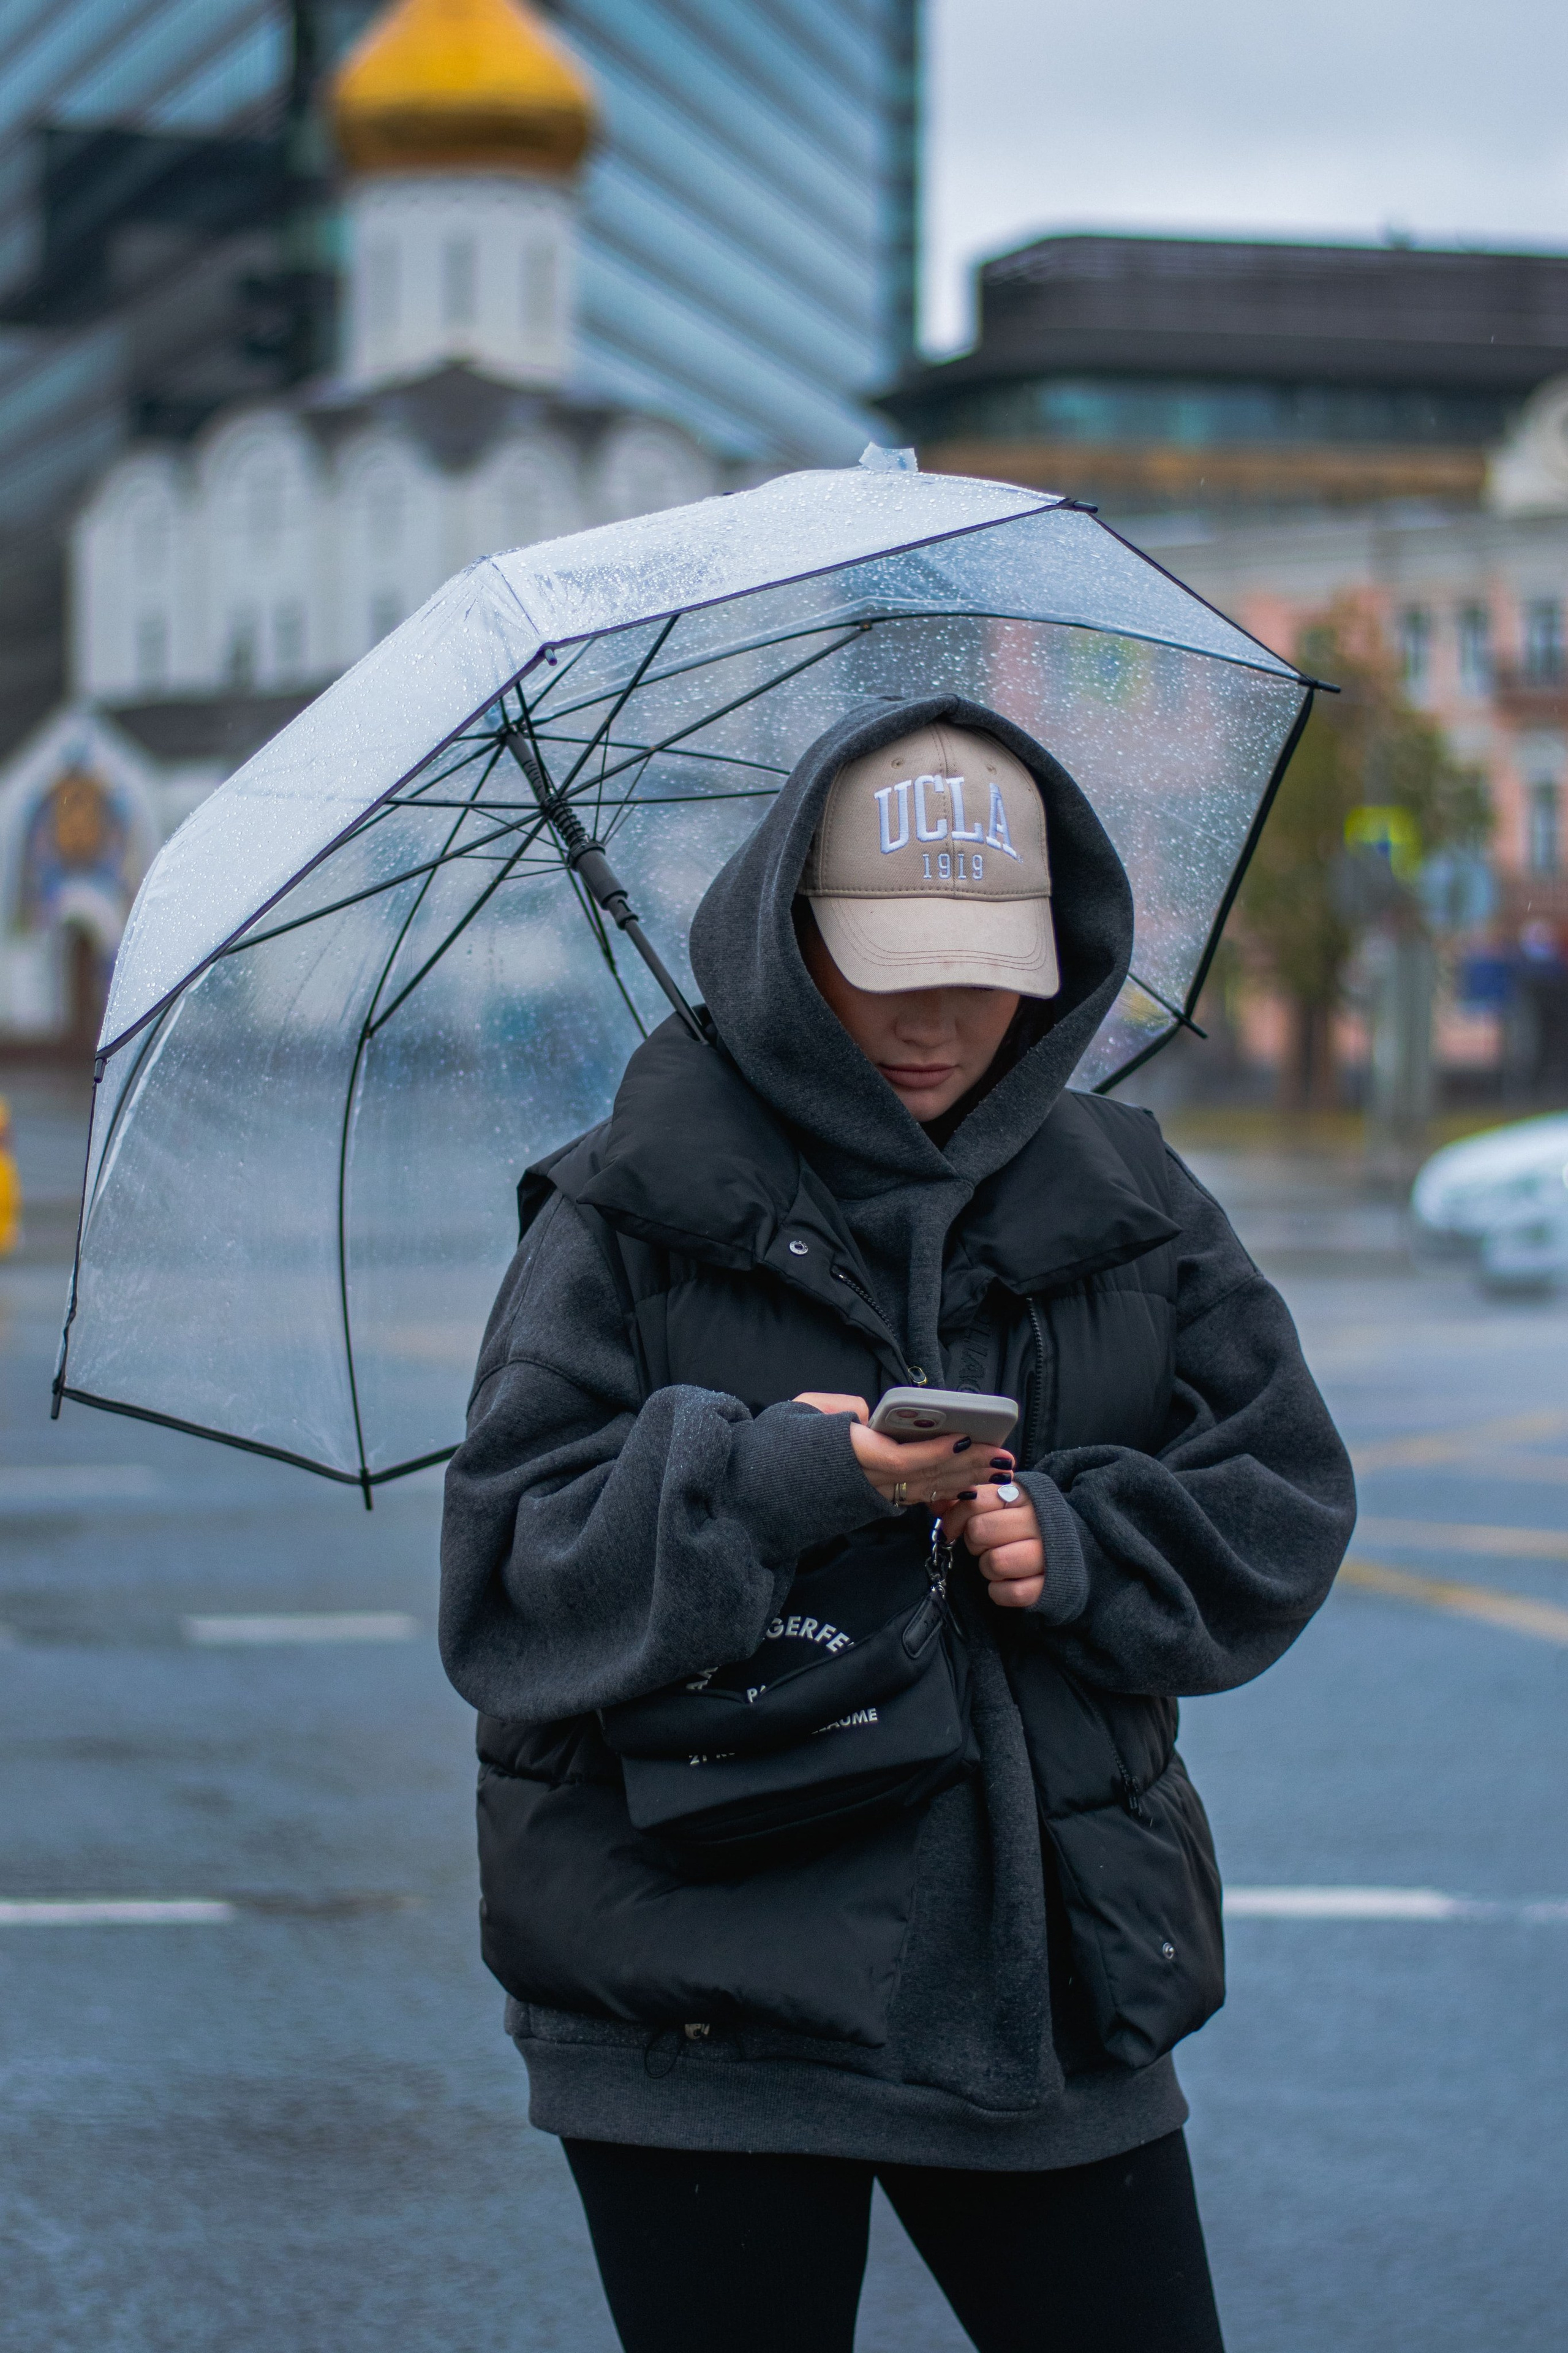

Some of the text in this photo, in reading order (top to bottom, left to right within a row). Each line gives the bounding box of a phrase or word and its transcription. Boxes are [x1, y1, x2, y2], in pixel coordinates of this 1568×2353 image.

[874, 774, 1017, 859] UCLA
[922, 853, 984, 880] 1919
[764, 1615, 854, 1653] GERFE
